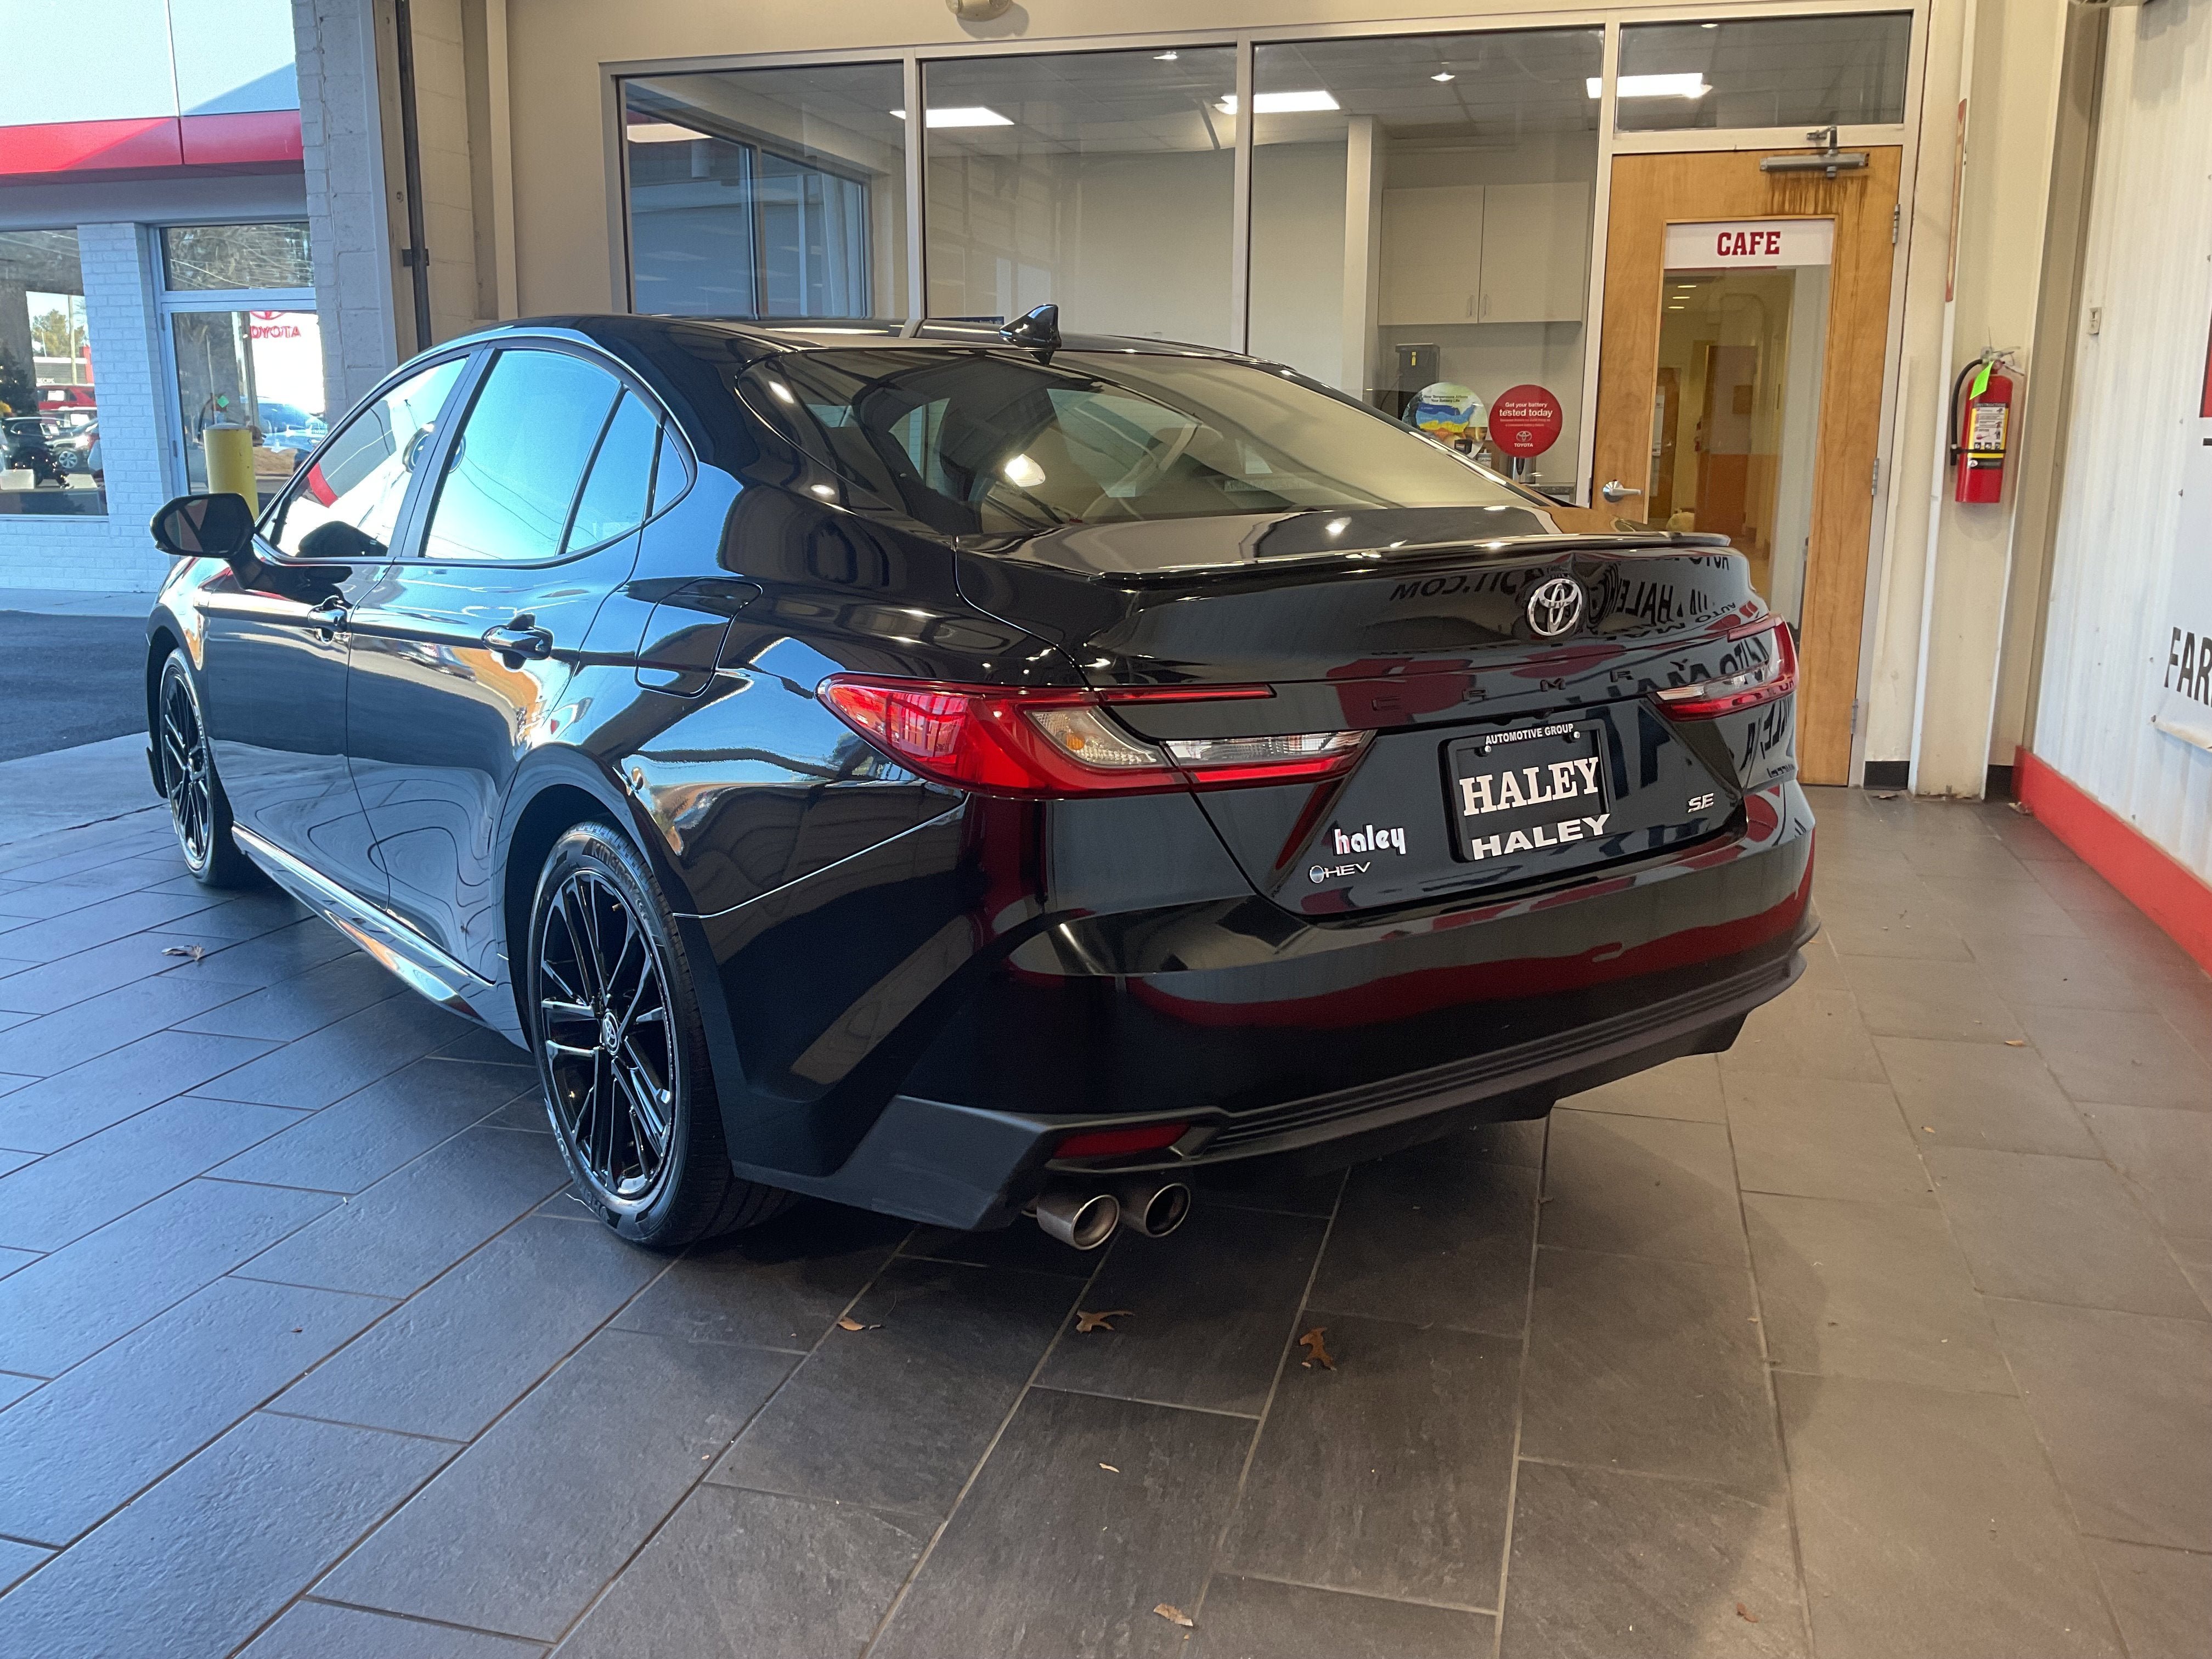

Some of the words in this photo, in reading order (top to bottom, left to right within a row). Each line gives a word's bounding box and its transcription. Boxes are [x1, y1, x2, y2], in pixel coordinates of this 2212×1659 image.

[1717, 231, 1781, 256] CAFE
[250, 325, 301, 338] OYOTA
[1528, 409, 1553, 417] today
[2164, 627, 2212, 708] FAR
[1485, 727, 1543, 745] AUTOMOTIVE
[1544, 723, 1574, 736] GROUP
[1459, 757, 1599, 816] HALEY
[1688, 793, 1714, 812] SE
[1334, 825, 1406, 855] haley
[1471, 813, 1610, 860] HALEY
